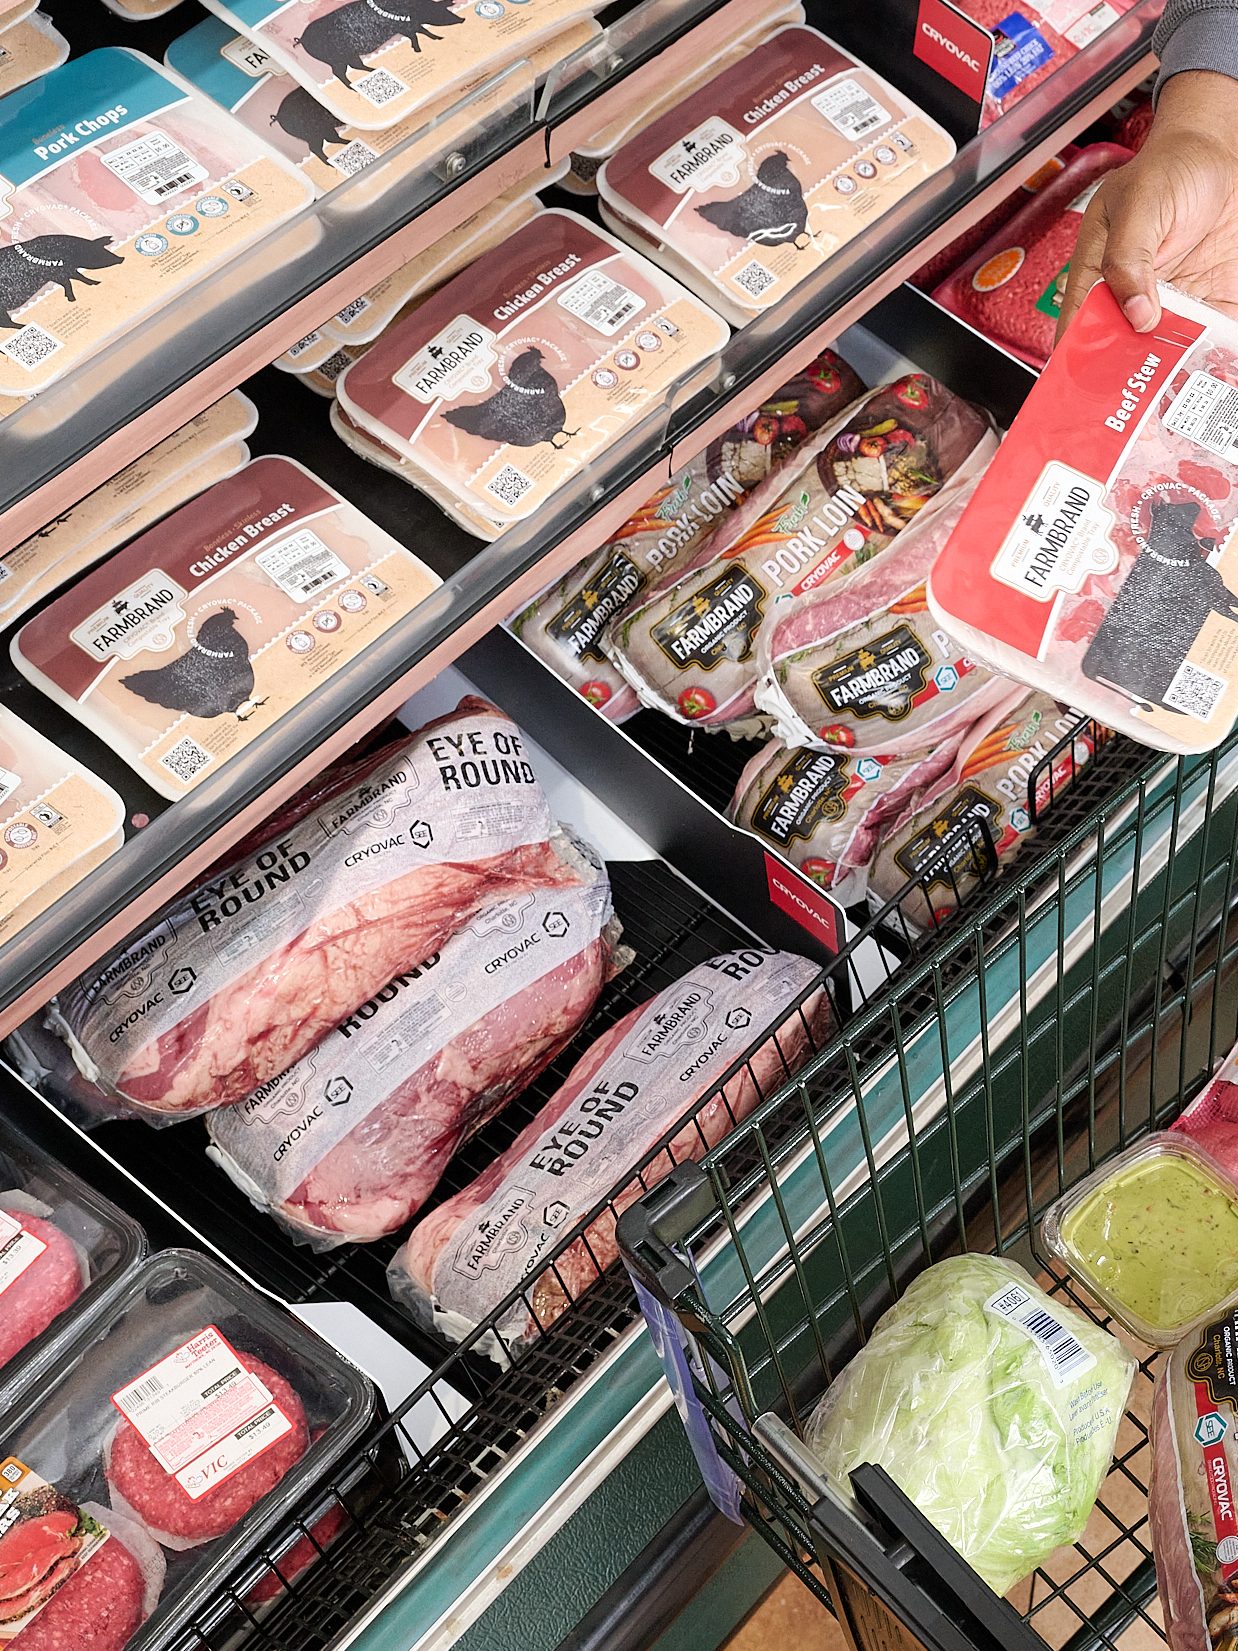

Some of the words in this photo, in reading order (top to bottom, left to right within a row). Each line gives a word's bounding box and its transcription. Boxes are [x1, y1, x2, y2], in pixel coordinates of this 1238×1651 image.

[922, 22, 981, 73] CRYOVAC
[743, 86, 789, 124] Chicken
[783, 63, 825, 92] Breast
[34, 132, 79, 160] Pork
[75, 103, 128, 136] Chops
[670, 133, 734, 183] FARMBRAND
[493, 284, 544, 321] Chicken
[537, 253, 582, 285] Breast
[416, 332, 484, 394] FARMBRAND
[1104, 388, 1141, 433] Beef
[1127, 352, 1162, 394] Stew
[189, 535, 249, 578] Chicken
[243, 502, 296, 538] Breast
[646, 512, 699, 573] PORK
[691, 471, 745, 522] LOIN
[761, 526, 826, 588] PORK
[812, 485, 867, 538] LOIN
[1025, 485, 1090, 587] FARMBRAND
[1135, 536, 1190, 567] FARMBRAND
[1188, 486, 1222, 520] PACKAGE
[801, 551, 841, 591] CRYOVAC
[93, 588, 174, 652] FARMBRAND
[567, 572, 639, 654] FARMBRAND
[671, 583, 754, 660] FARMBRAND
[723, 610, 749, 634] PRODUCT
[829, 648, 920, 707] FARMBRAND
[426, 732, 488, 763] EYE
[493, 731, 524, 756] OF
[439, 759, 536, 791] ROUND
[332, 771, 407, 830] FARMBRAND
[771, 755, 835, 838] FARMBRAND
[344, 834, 405, 868] CRYOVAC
[414, 829, 428, 839] SEE
[189, 870, 250, 915] EYE
[255, 838, 294, 871] OF
[197, 850, 311, 933] ROUND
[772, 878, 830, 929] CRYOVAC
[548, 919, 563, 930] SEE
[91, 934, 166, 994] FARMBRAND
[173, 974, 189, 988] SEE
[484, 933, 541, 975] CRYOVAC
[109, 992, 164, 1044] CRYOVAC
[642, 992, 702, 1056] FARMBRAND
[679, 1033, 728, 1082] CRYOVAC
[273, 1105, 324, 1162] CRYOVAC
[529, 1121, 581, 1171] EYE
[579, 1080, 611, 1113] OF
[549, 1081, 639, 1177] ROUND
[467, 1198, 525, 1270] FARMBRAND
[999, 1291, 1023, 1313] #4061
[186, 1332, 214, 1353] Harris
[191, 1337, 218, 1359] Teeter
[1223, 1326, 1233, 1358] ORGANIC
[203, 1382, 222, 1398] TOTAL
[1216, 1366, 1226, 1379] NC
[1226, 1359, 1236, 1386] PRODUCT
[237, 1422, 255, 1437] TOTAL
[253, 1410, 273, 1426] PRICE
[1205, 1419, 1215, 1438] SEE
[200, 1454, 228, 1481] VIC
[1212, 1457, 1233, 1521] CRYOVAC
